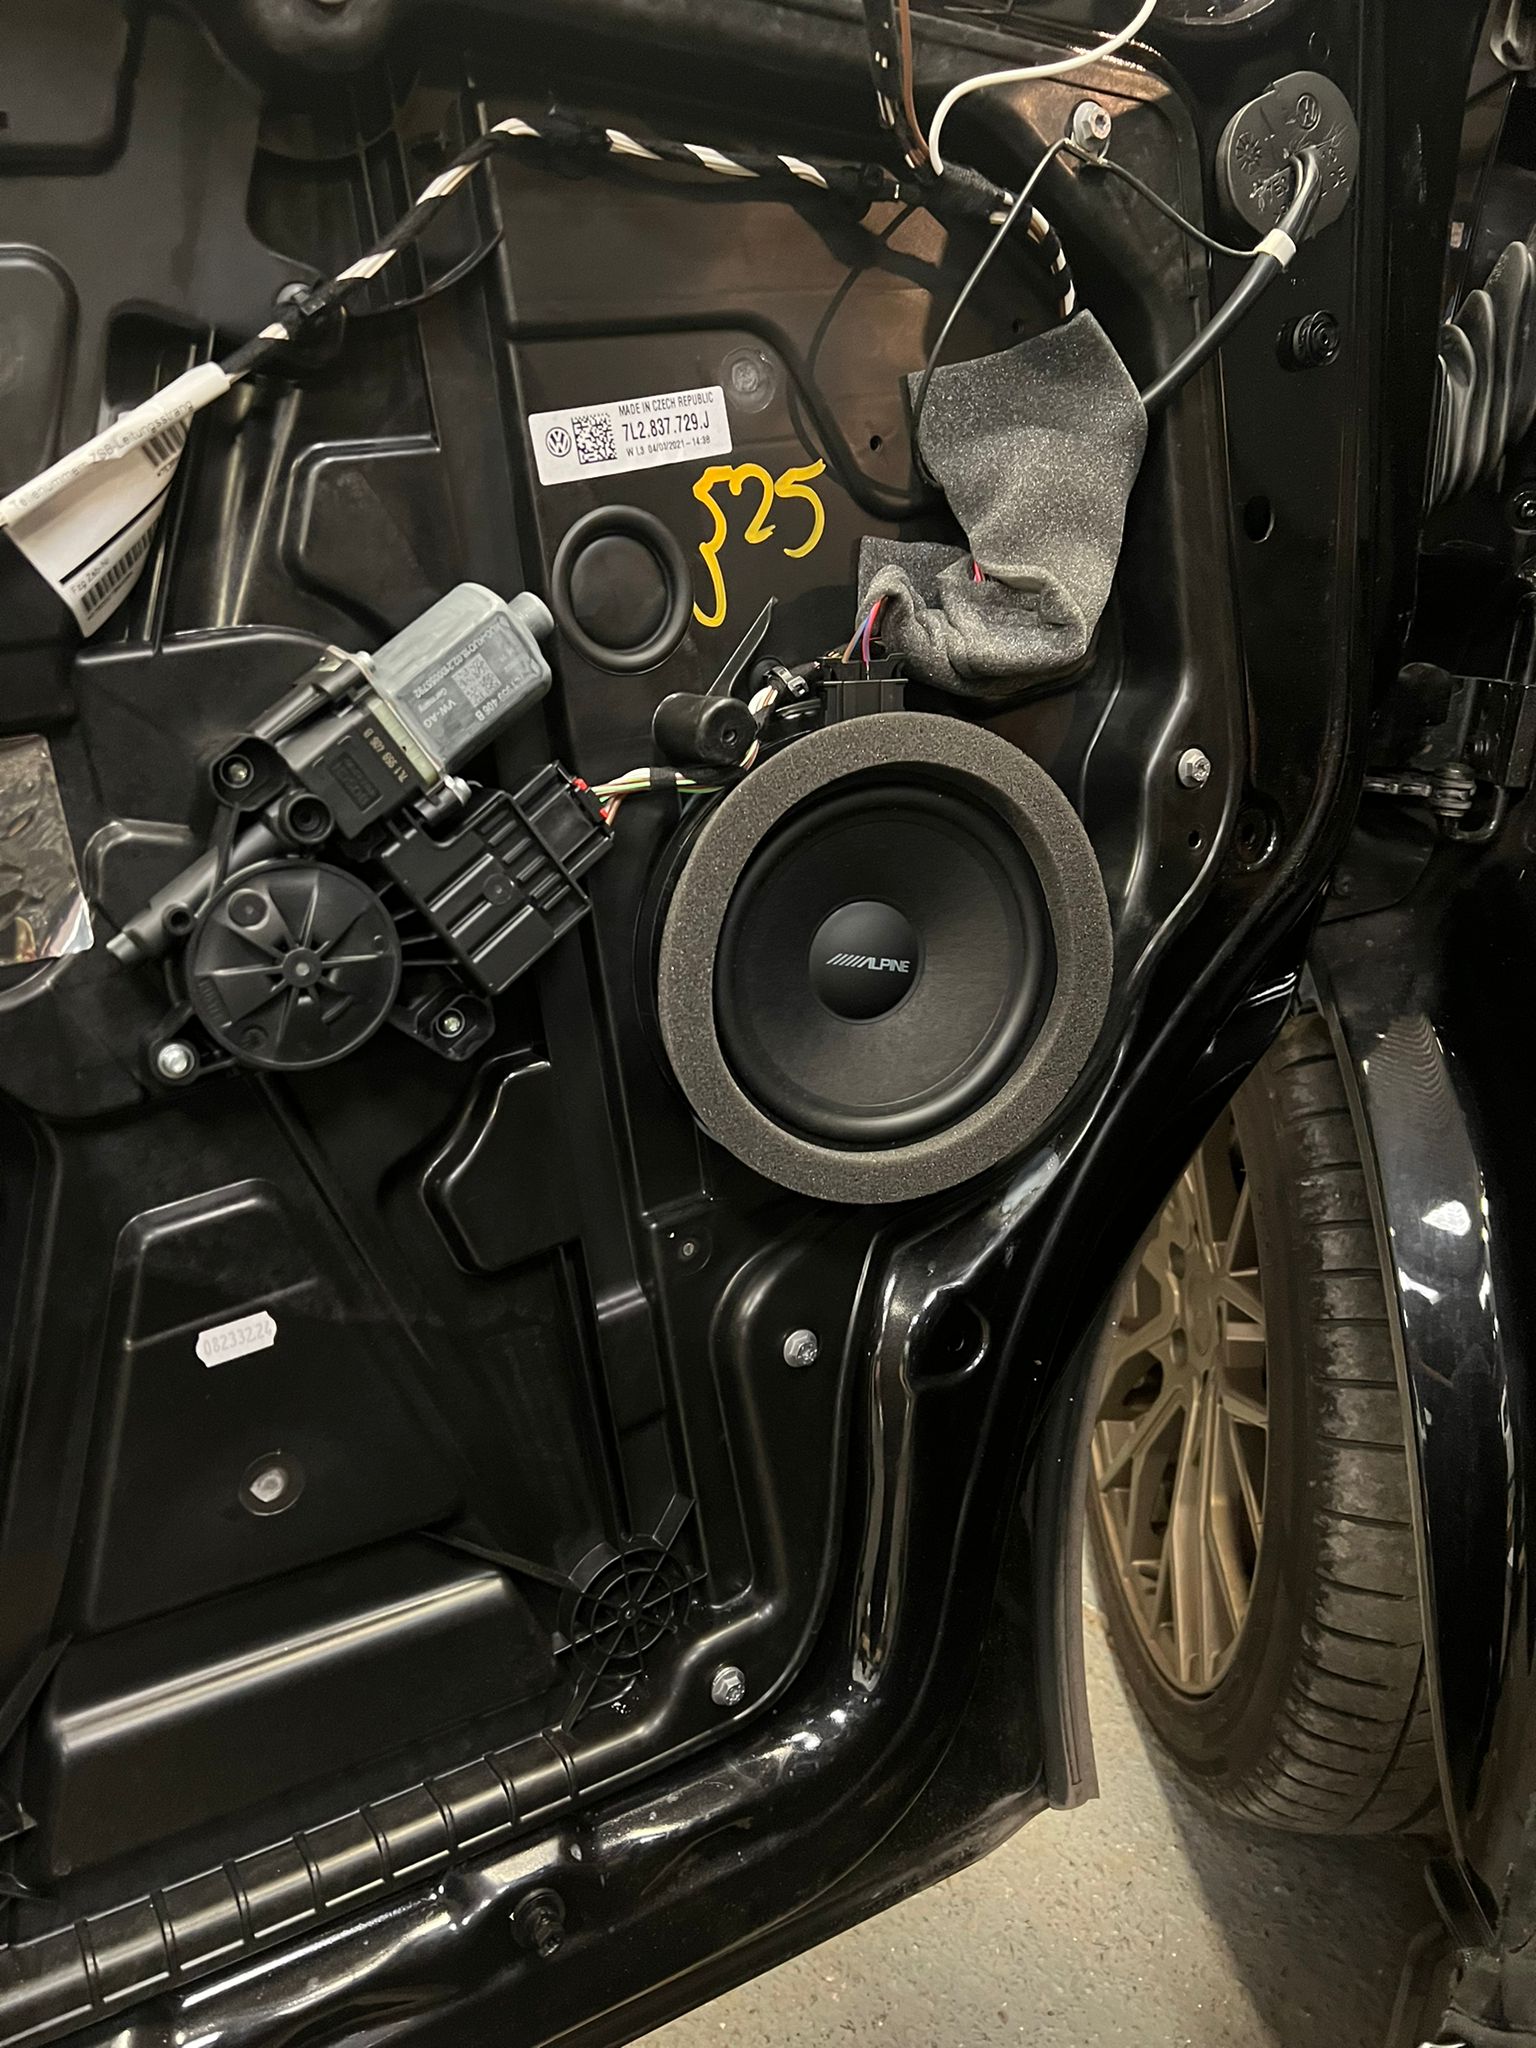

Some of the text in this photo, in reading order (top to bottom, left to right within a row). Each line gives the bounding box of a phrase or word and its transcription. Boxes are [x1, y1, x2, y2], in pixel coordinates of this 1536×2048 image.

[618, 391, 714, 416] MADE IN CZECH REPUBLIC
[622, 410, 710, 442] 7L2.837.729.J
[857, 956, 911, 973] ALPINE
